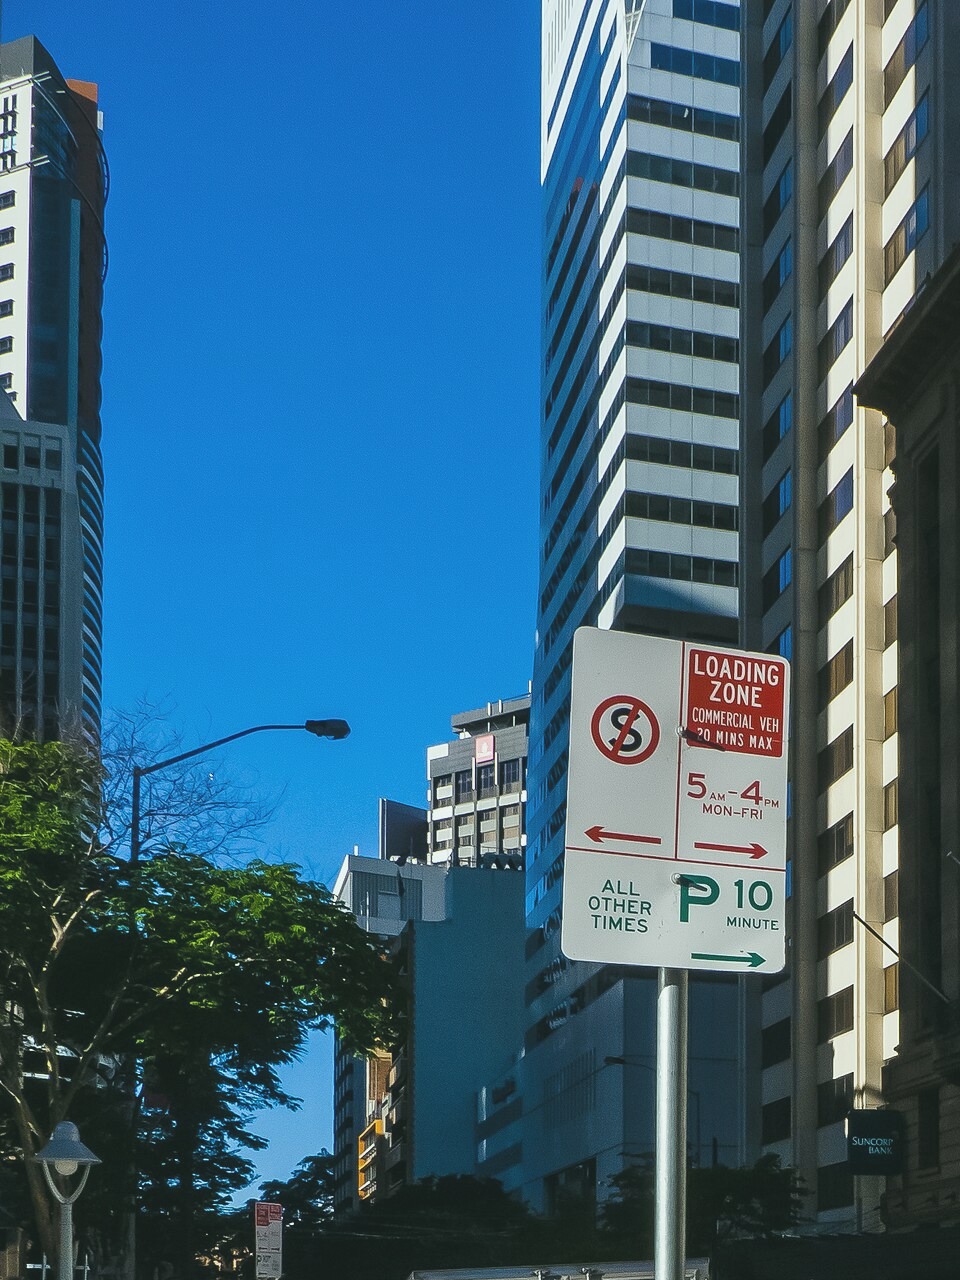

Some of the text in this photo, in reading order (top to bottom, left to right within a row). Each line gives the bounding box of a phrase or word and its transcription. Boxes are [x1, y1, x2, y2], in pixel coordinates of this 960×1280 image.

[694, 653, 779, 687] LOADING
[709, 680, 763, 708] ZONE
[692, 707, 779, 733] COMMERCIAL VEH
[716, 730, 744, 747] MINS
[749, 735, 773, 750] MAX
[702, 803, 763, 820] MON-FRI
[601, 879, 641, 897] ALL
[588, 896, 652, 916] OTHER
[680, 873, 773, 923] P 10
[591, 914, 649, 933] TIMES
[727, 916, 780, 931] MINUTE
[852, 1136, 894, 1146] SUNCORP
[868, 1146, 892, 1154] BANK
